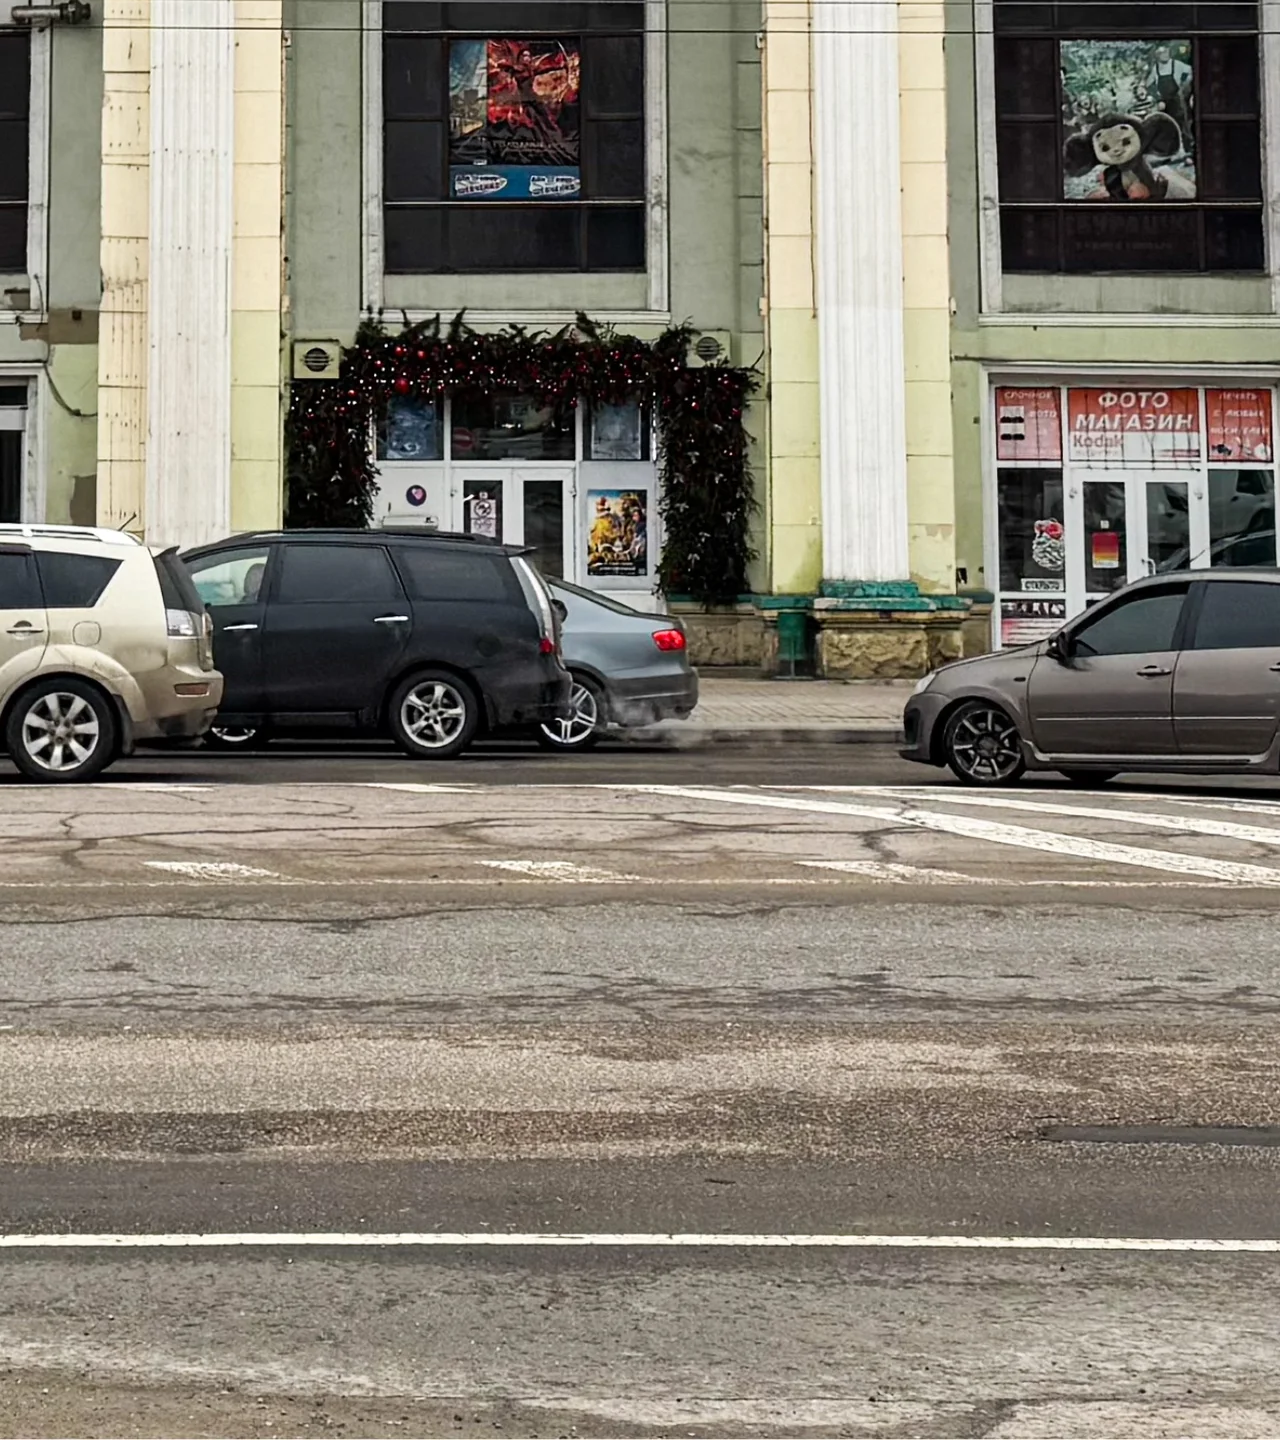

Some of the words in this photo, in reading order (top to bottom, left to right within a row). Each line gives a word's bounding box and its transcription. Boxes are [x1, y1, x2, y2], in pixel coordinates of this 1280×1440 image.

[1098, 391, 1169, 409] ФОТО
[1075, 413, 1193, 430] МАГАЗИН
[1073, 433, 1122, 448] Kodak
